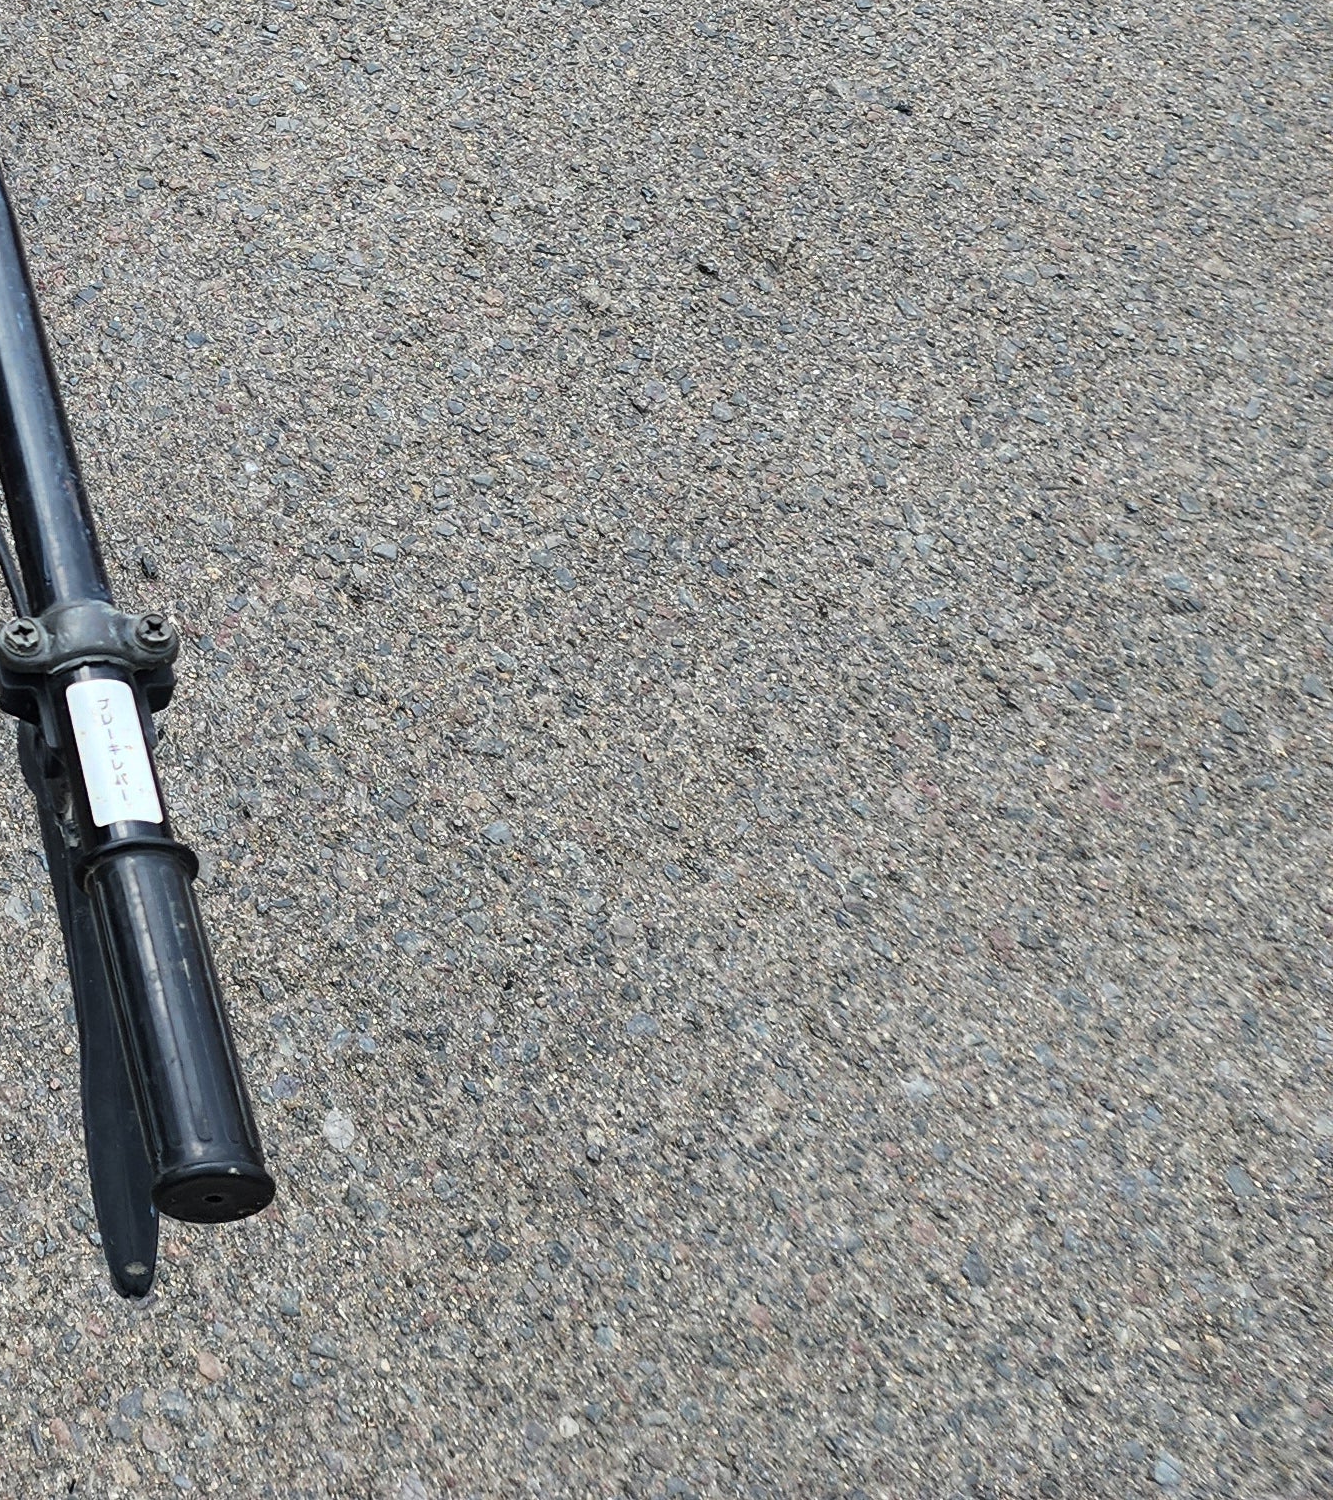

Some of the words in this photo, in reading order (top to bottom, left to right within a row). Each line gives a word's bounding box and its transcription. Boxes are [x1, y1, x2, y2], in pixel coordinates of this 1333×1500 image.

[97, 699, 129, 802] ブレーキレバー
